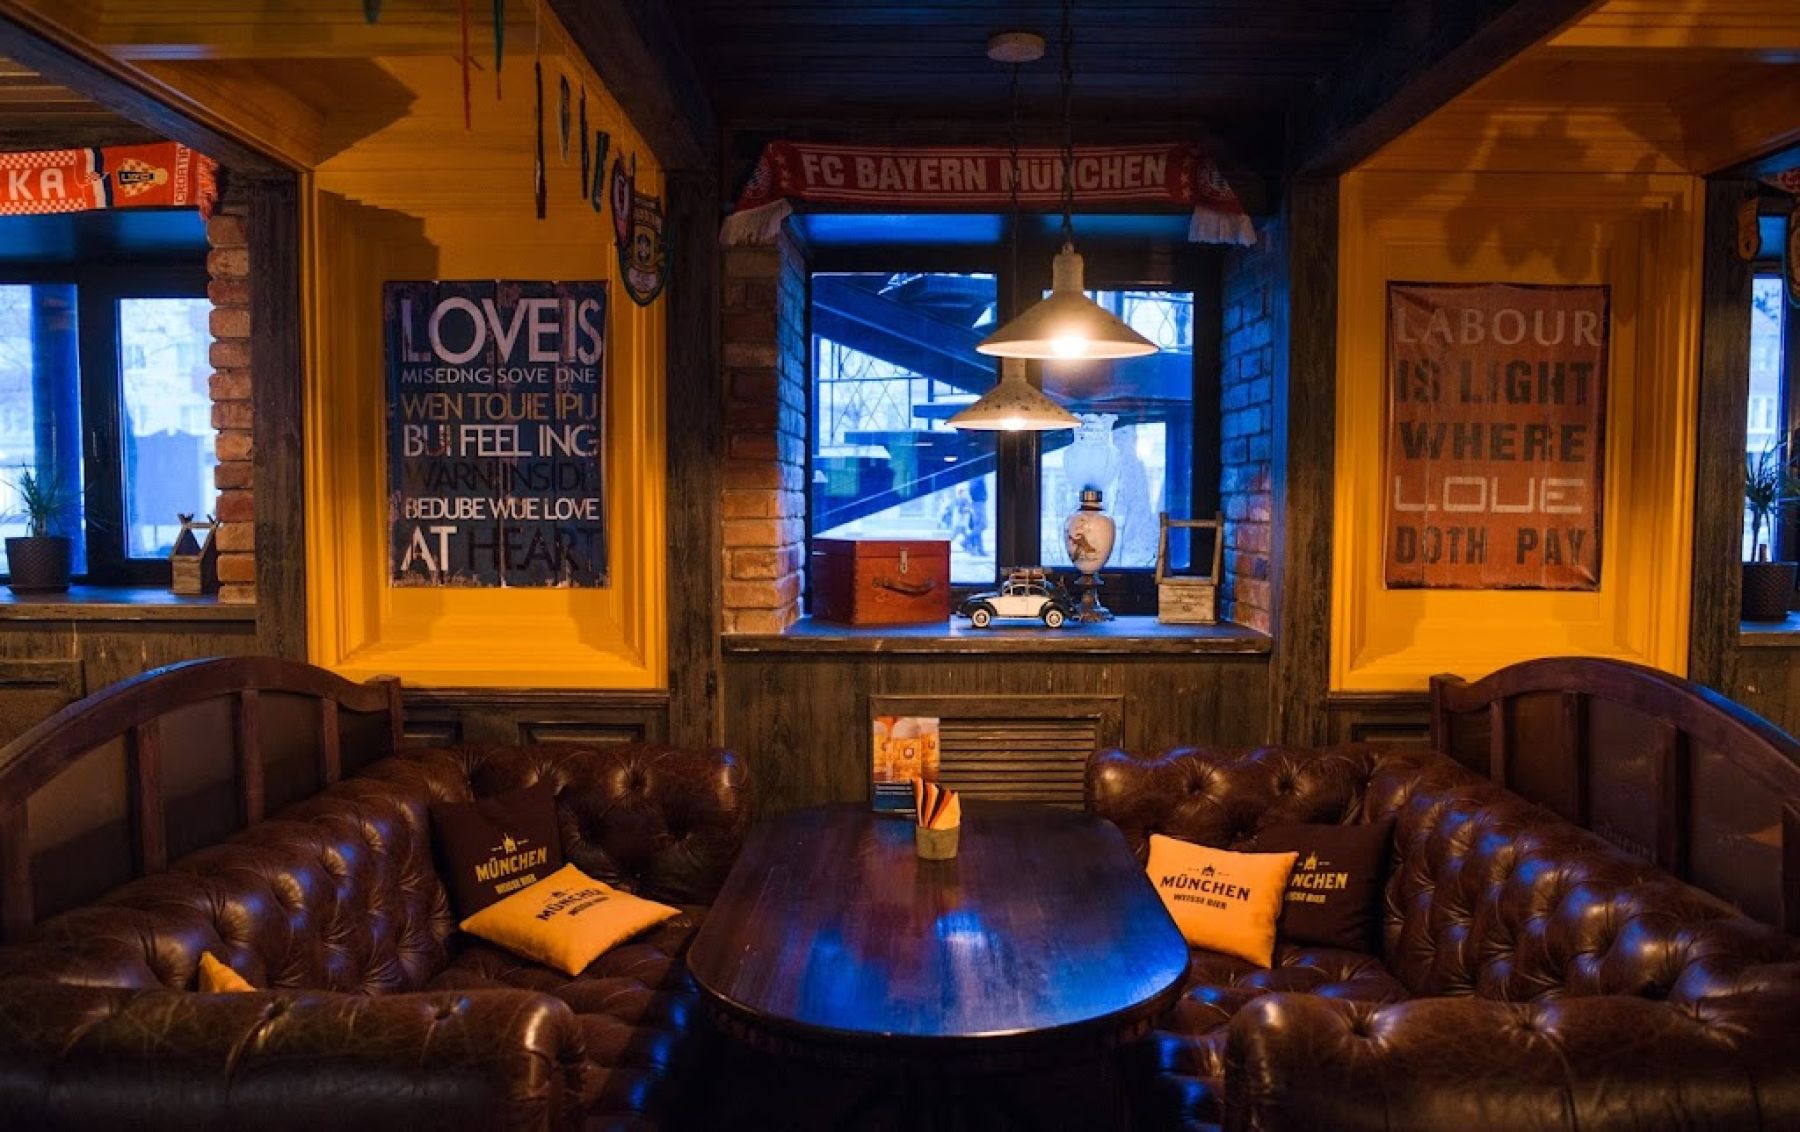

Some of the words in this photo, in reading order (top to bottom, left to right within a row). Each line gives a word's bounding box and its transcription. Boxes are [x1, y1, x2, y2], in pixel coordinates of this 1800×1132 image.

[802, 154, 845, 186] FC
[855, 157, 987, 191] BAYERN
[1001, 153, 1168, 191] MÜNCHEN
[1397, 307, 1600, 347] LABOUR
[497, 367, 548, 384] SOVE
[1397, 358, 1440, 404] IS
[1460, 359, 1595, 406] LIGHT
[401, 392, 462, 420] WEN
[1400, 422, 1586, 462] WHERE
[545, 497, 600, 520] LOVE
[400, 525, 457, 571] AT
[468, 527, 602, 571] HEART
[1396, 526, 1488, 565] DOTH
[1517, 527, 1586, 566] PAY
[475, 847, 548, 883] MÜNCHEN
[1291, 872, 1349, 889] NCHEN
[1160, 873, 1251, 902] MÜNCHEN
